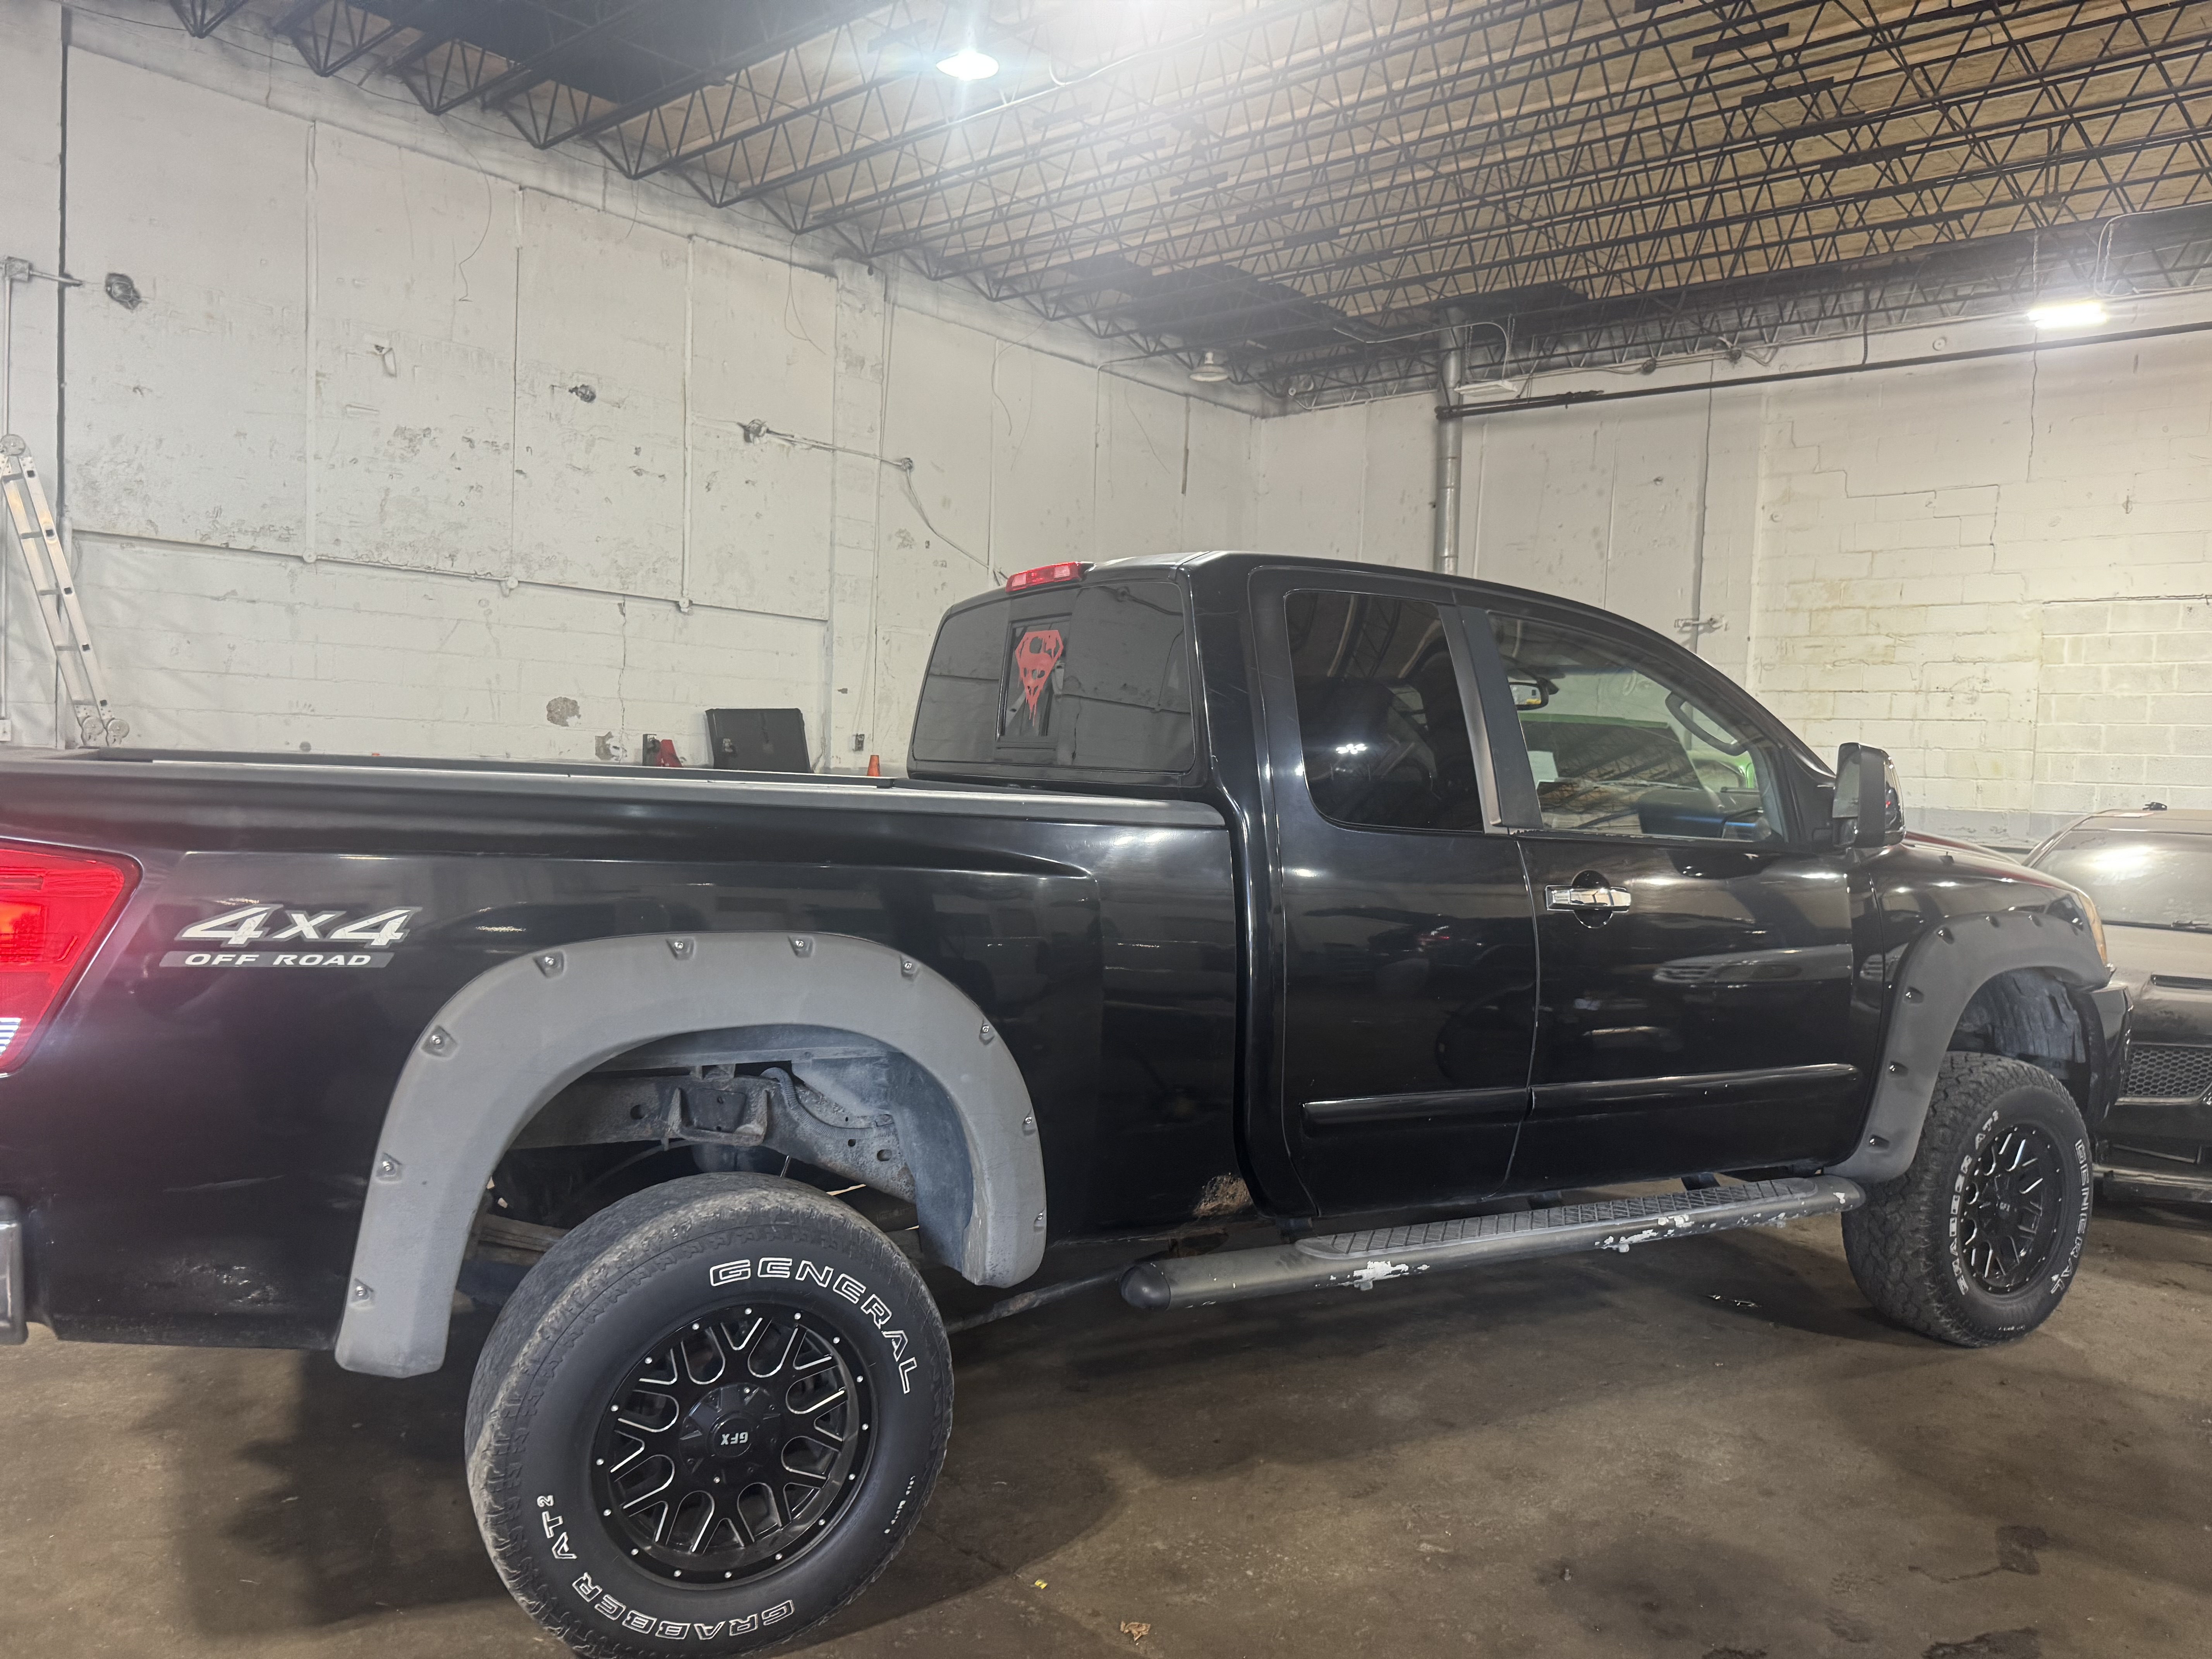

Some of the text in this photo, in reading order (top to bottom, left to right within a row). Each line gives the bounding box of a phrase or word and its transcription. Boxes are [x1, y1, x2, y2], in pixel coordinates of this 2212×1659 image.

[184, 953, 371, 966] OFF ROAD
[1949, 1154, 1972, 1295] GRABBER
[2051, 1139, 2089, 1294] GENERAL
[710, 1257, 917, 1394] GENERAL
[721, 1432, 749, 1445] GFX
[572, 1572, 795, 1640] GRABBER
